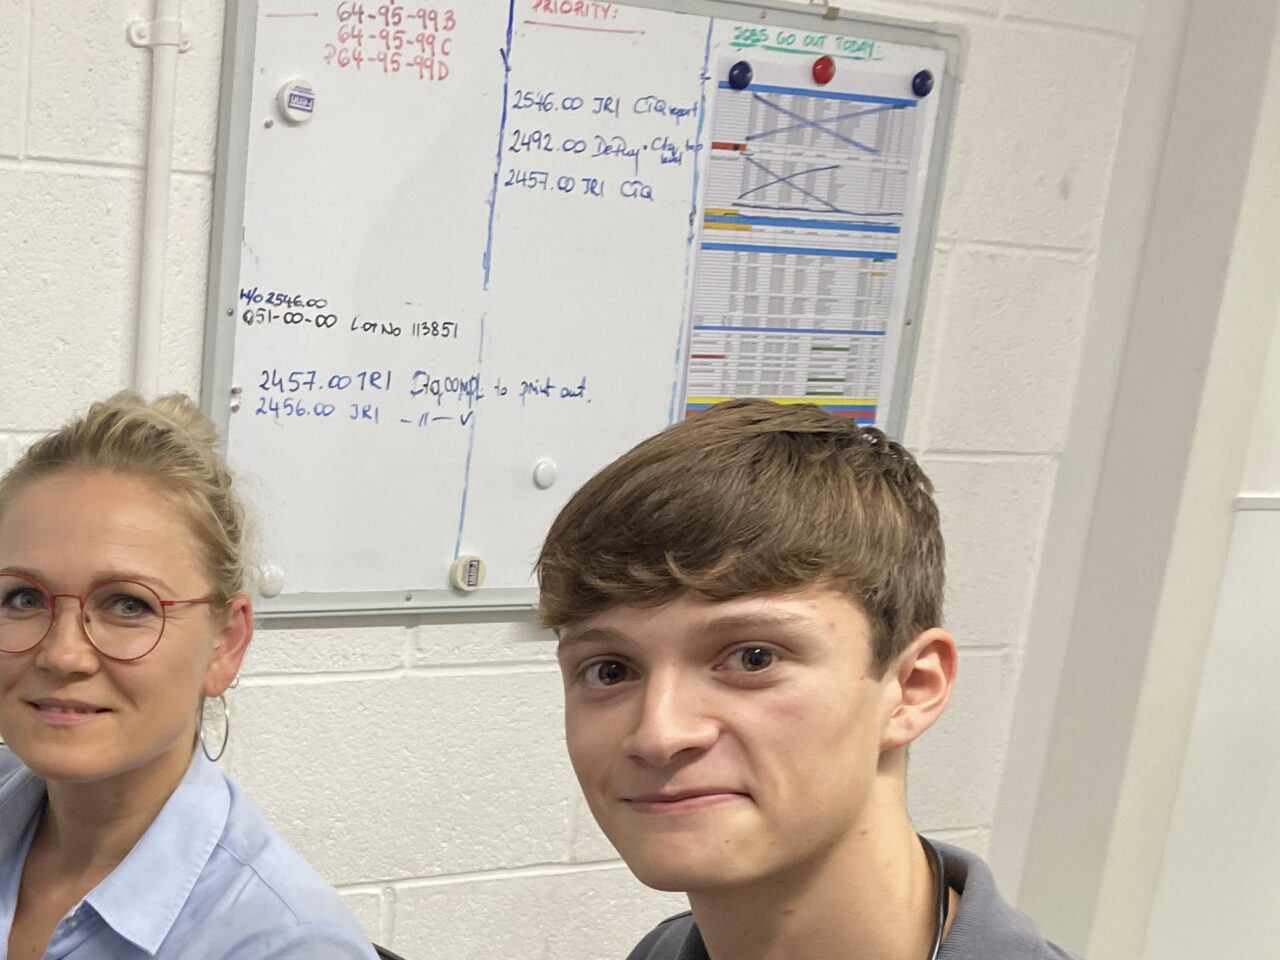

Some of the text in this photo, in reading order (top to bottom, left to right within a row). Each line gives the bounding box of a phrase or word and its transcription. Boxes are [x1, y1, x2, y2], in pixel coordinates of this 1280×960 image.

[509, 129, 587, 154] 2492.00
[504, 168, 576, 193] 2457.00
[258, 368, 352, 394] 2457.00
[255, 396, 336, 420] 2456.00
